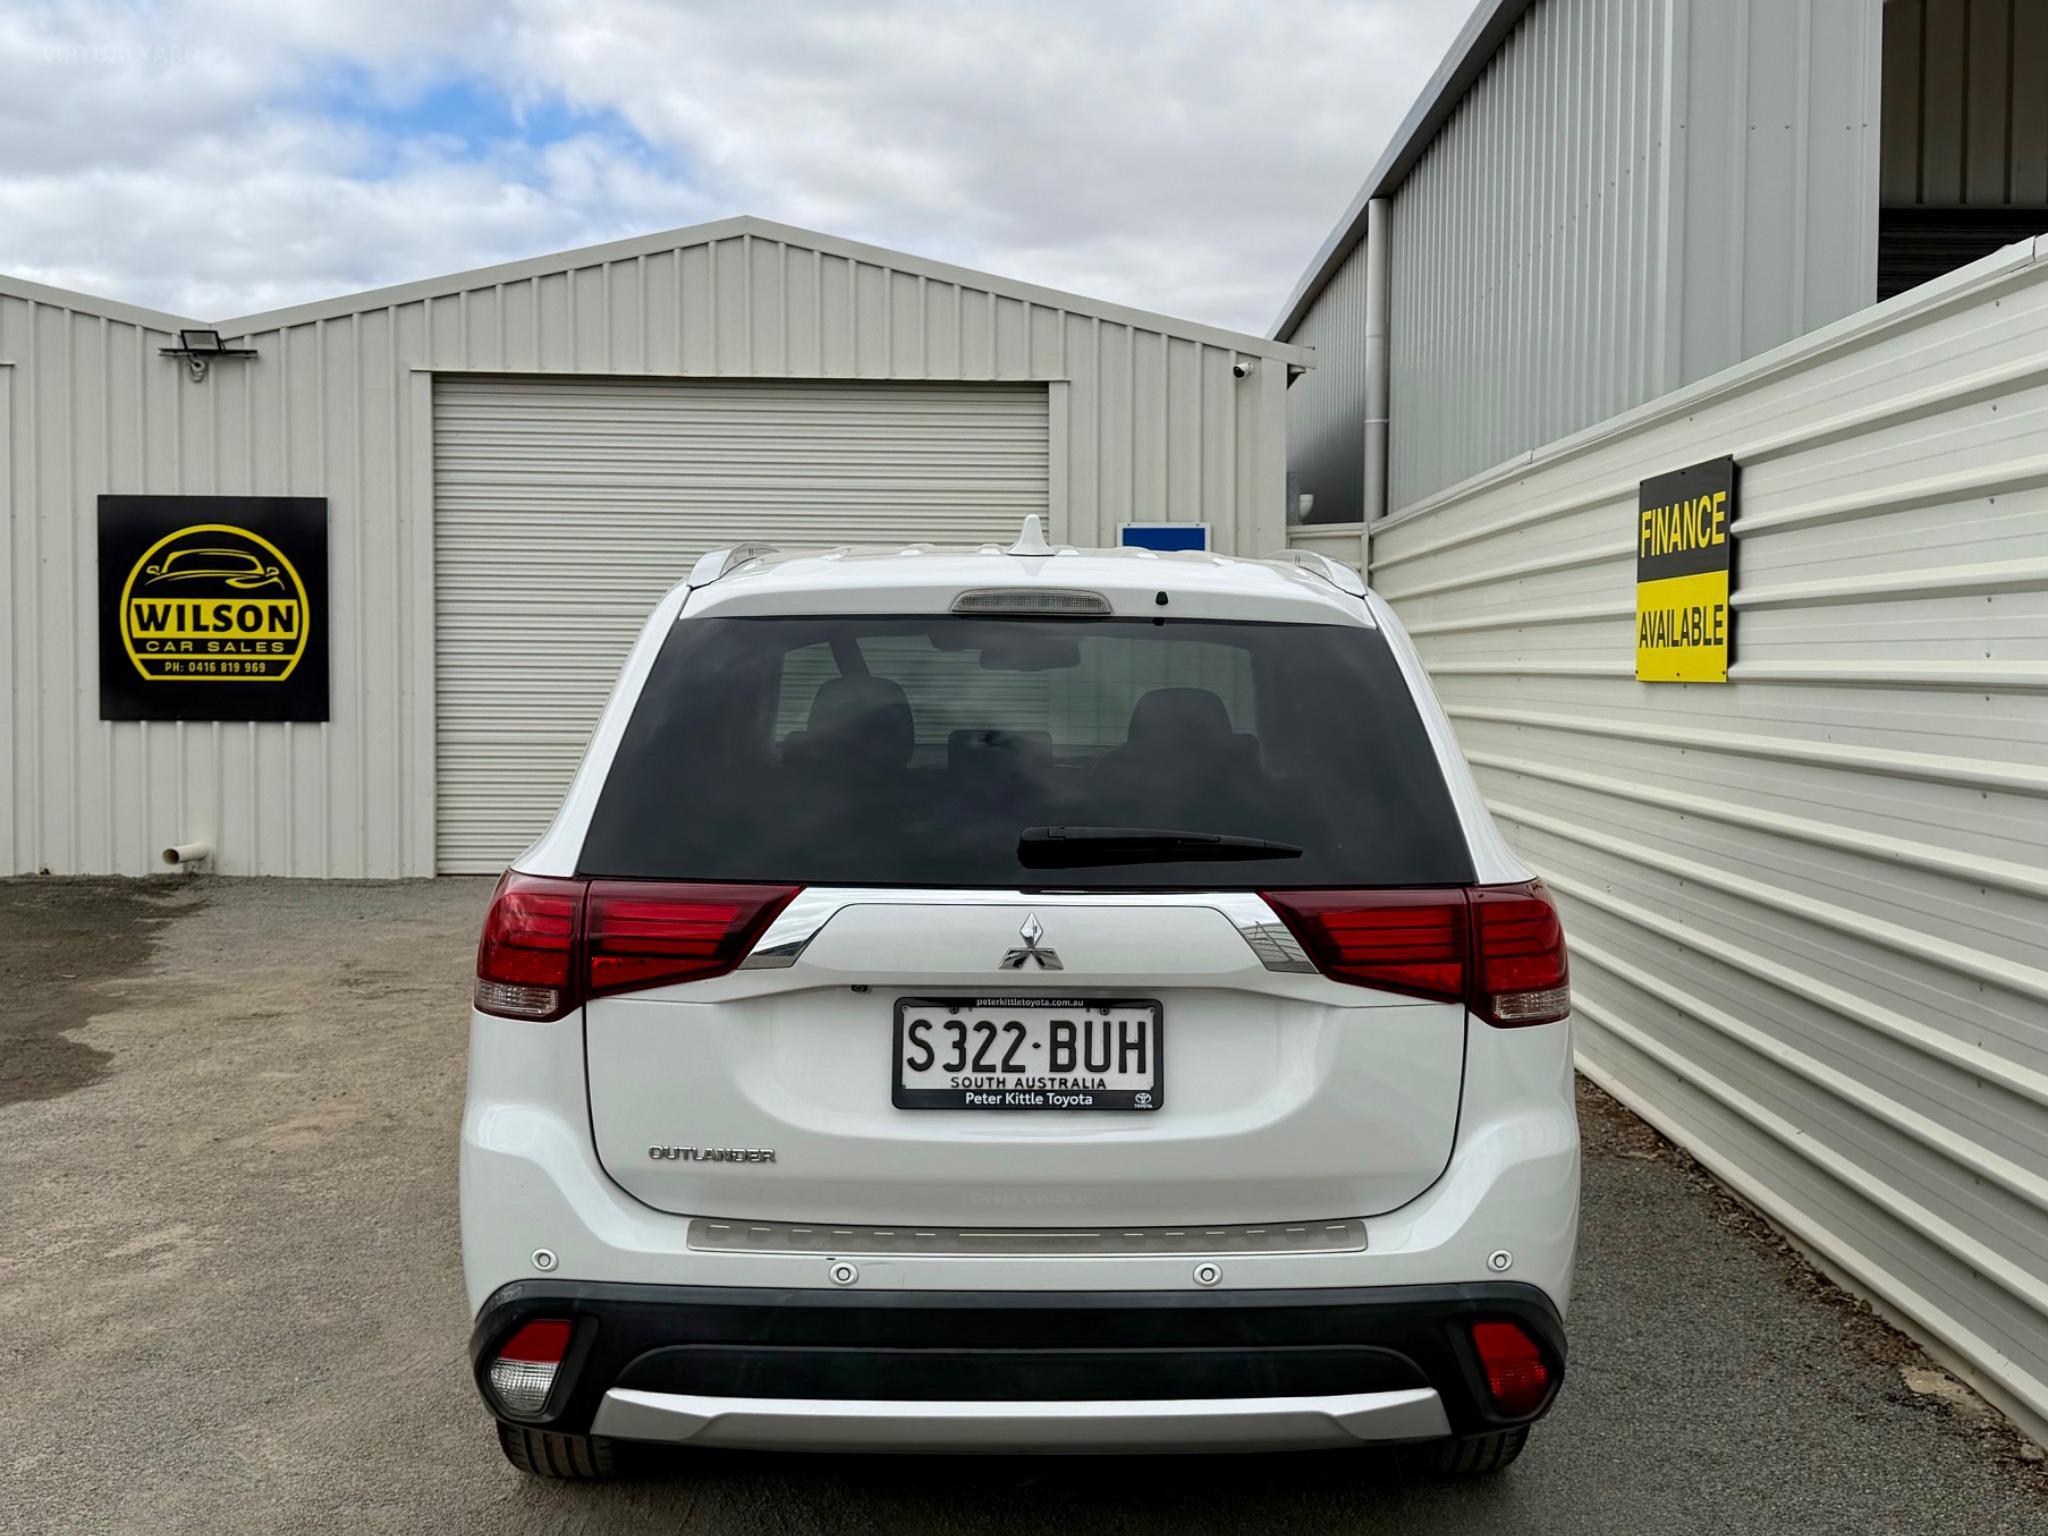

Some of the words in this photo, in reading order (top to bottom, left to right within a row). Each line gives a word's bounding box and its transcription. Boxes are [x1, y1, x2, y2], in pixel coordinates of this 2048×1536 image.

[1641, 491, 1727, 558] FINANCE
[134, 603, 294, 633] WILSON
[1639, 604, 1724, 649] AVAILABLE
[146, 640, 193, 652] CAR
[207, 641, 285, 653] SALES
[165, 661, 184, 673] PH:
[188, 661, 217, 673] 0416
[220, 661, 240, 673] 819
[244, 662, 266, 673] 969
[976, 997, 1084, 1008] peterkittletoyota.com.au
[950, 1077, 1007, 1089] SOUTH
[1014, 1077, 1107, 1090] AUSTRALIA
[965, 1092, 1002, 1105] Peter
[1005, 1092, 1043, 1105] Kittle
[1047, 1092, 1093, 1108] Toyota
[649, 1144, 777, 1163] OUTLANDER
